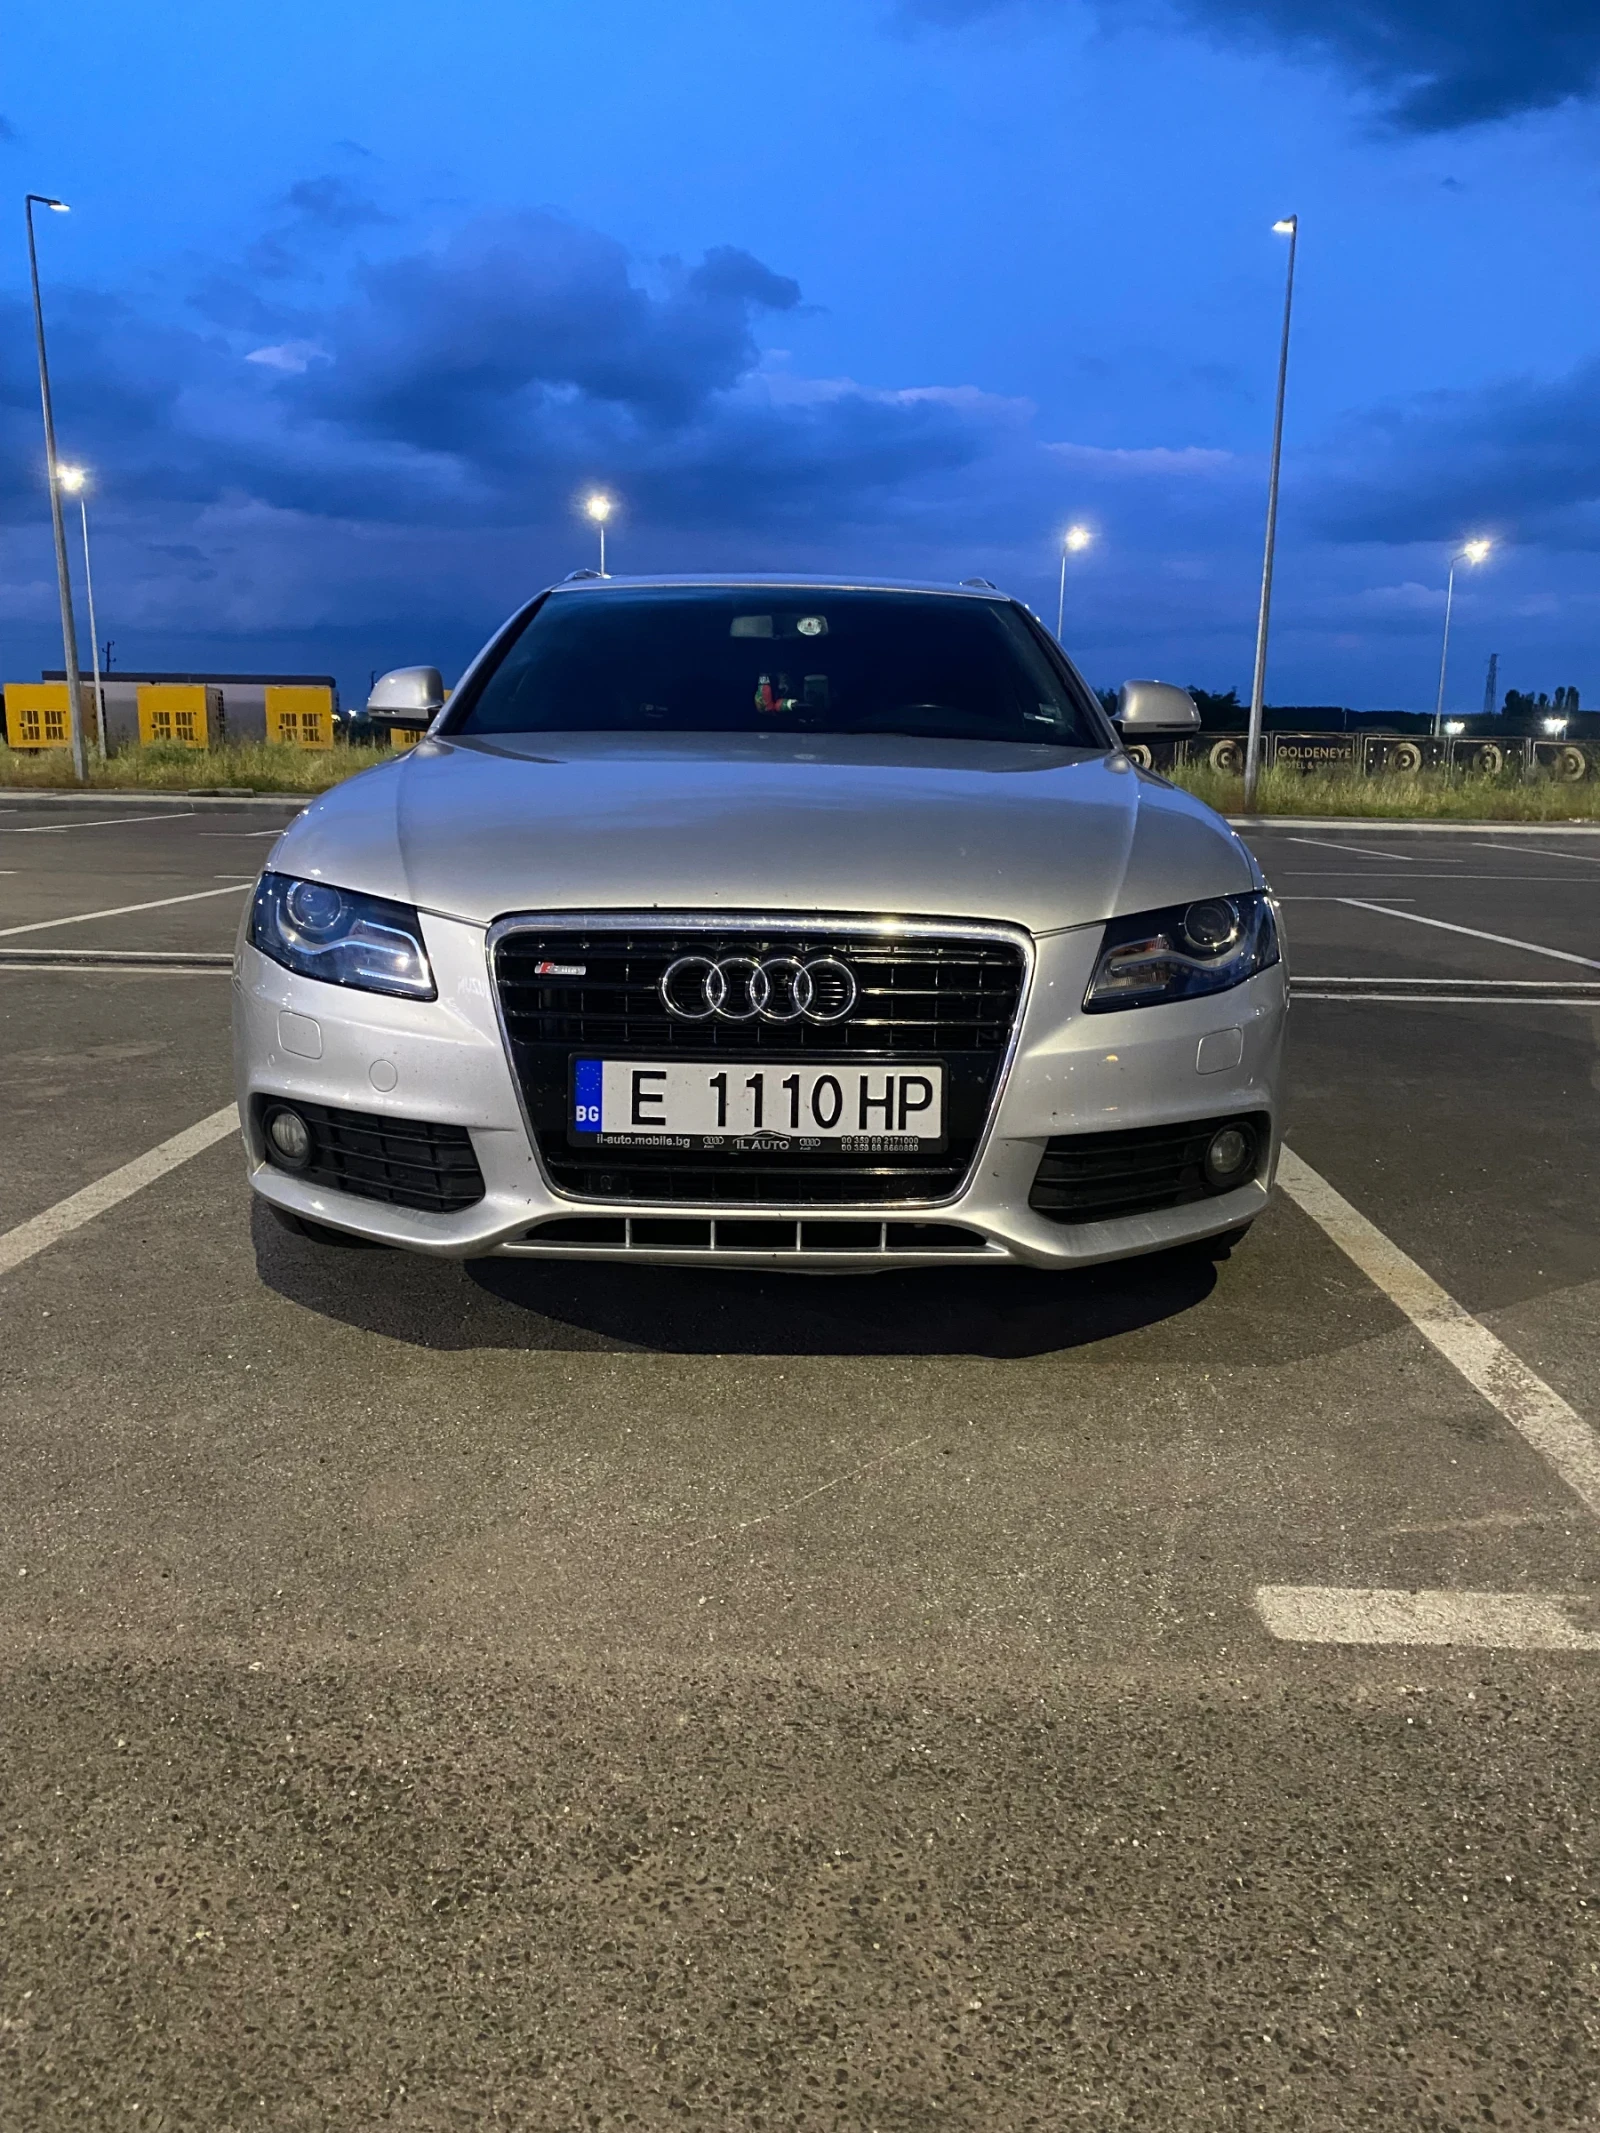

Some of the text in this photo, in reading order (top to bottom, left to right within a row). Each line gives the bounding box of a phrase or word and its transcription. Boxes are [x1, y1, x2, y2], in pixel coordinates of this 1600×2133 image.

[1278, 746, 1352, 759] GOLDENEYE
[1281, 761, 1306, 769] OTEL
[1307, 761, 1314, 770] &
[631, 1070, 667, 1126] E
[575, 1105, 600, 1122] BG
[597, 1134, 691, 1149] il-auto.mobile.bg
[736, 1139, 749, 1150] IL
[751, 1140, 790, 1151] AUTO
[841, 1136, 852, 1144] 00
[853, 1136, 870, 1144] 359
[883, 1136, 919, 1145] 2171000
